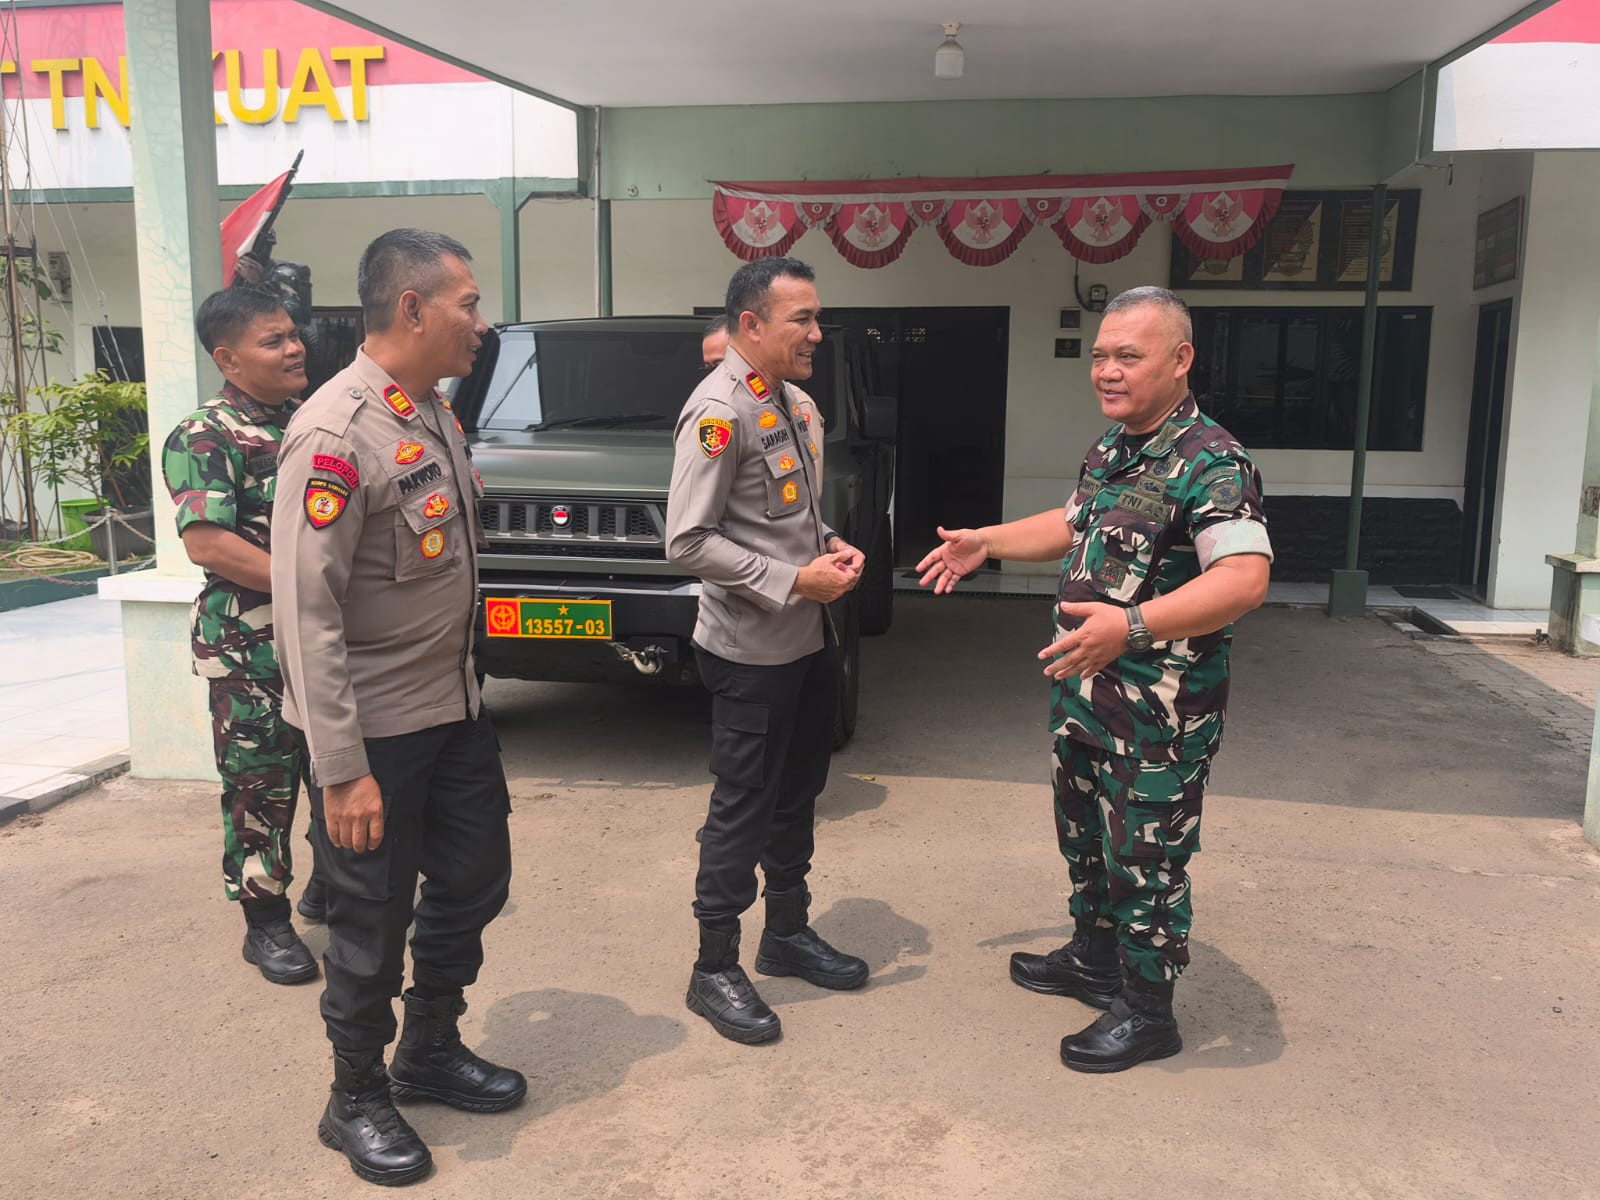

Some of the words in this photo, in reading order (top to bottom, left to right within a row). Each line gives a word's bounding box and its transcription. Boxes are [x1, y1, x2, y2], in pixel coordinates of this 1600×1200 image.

[31, 55, 131, 130] TN
[212, 45, 385, 125] UAT
[317, 457, 359, 486] PELOPOR
[1121, 493, 1142, 508] TNI
[525, 618, 606, 635] 13557-03
